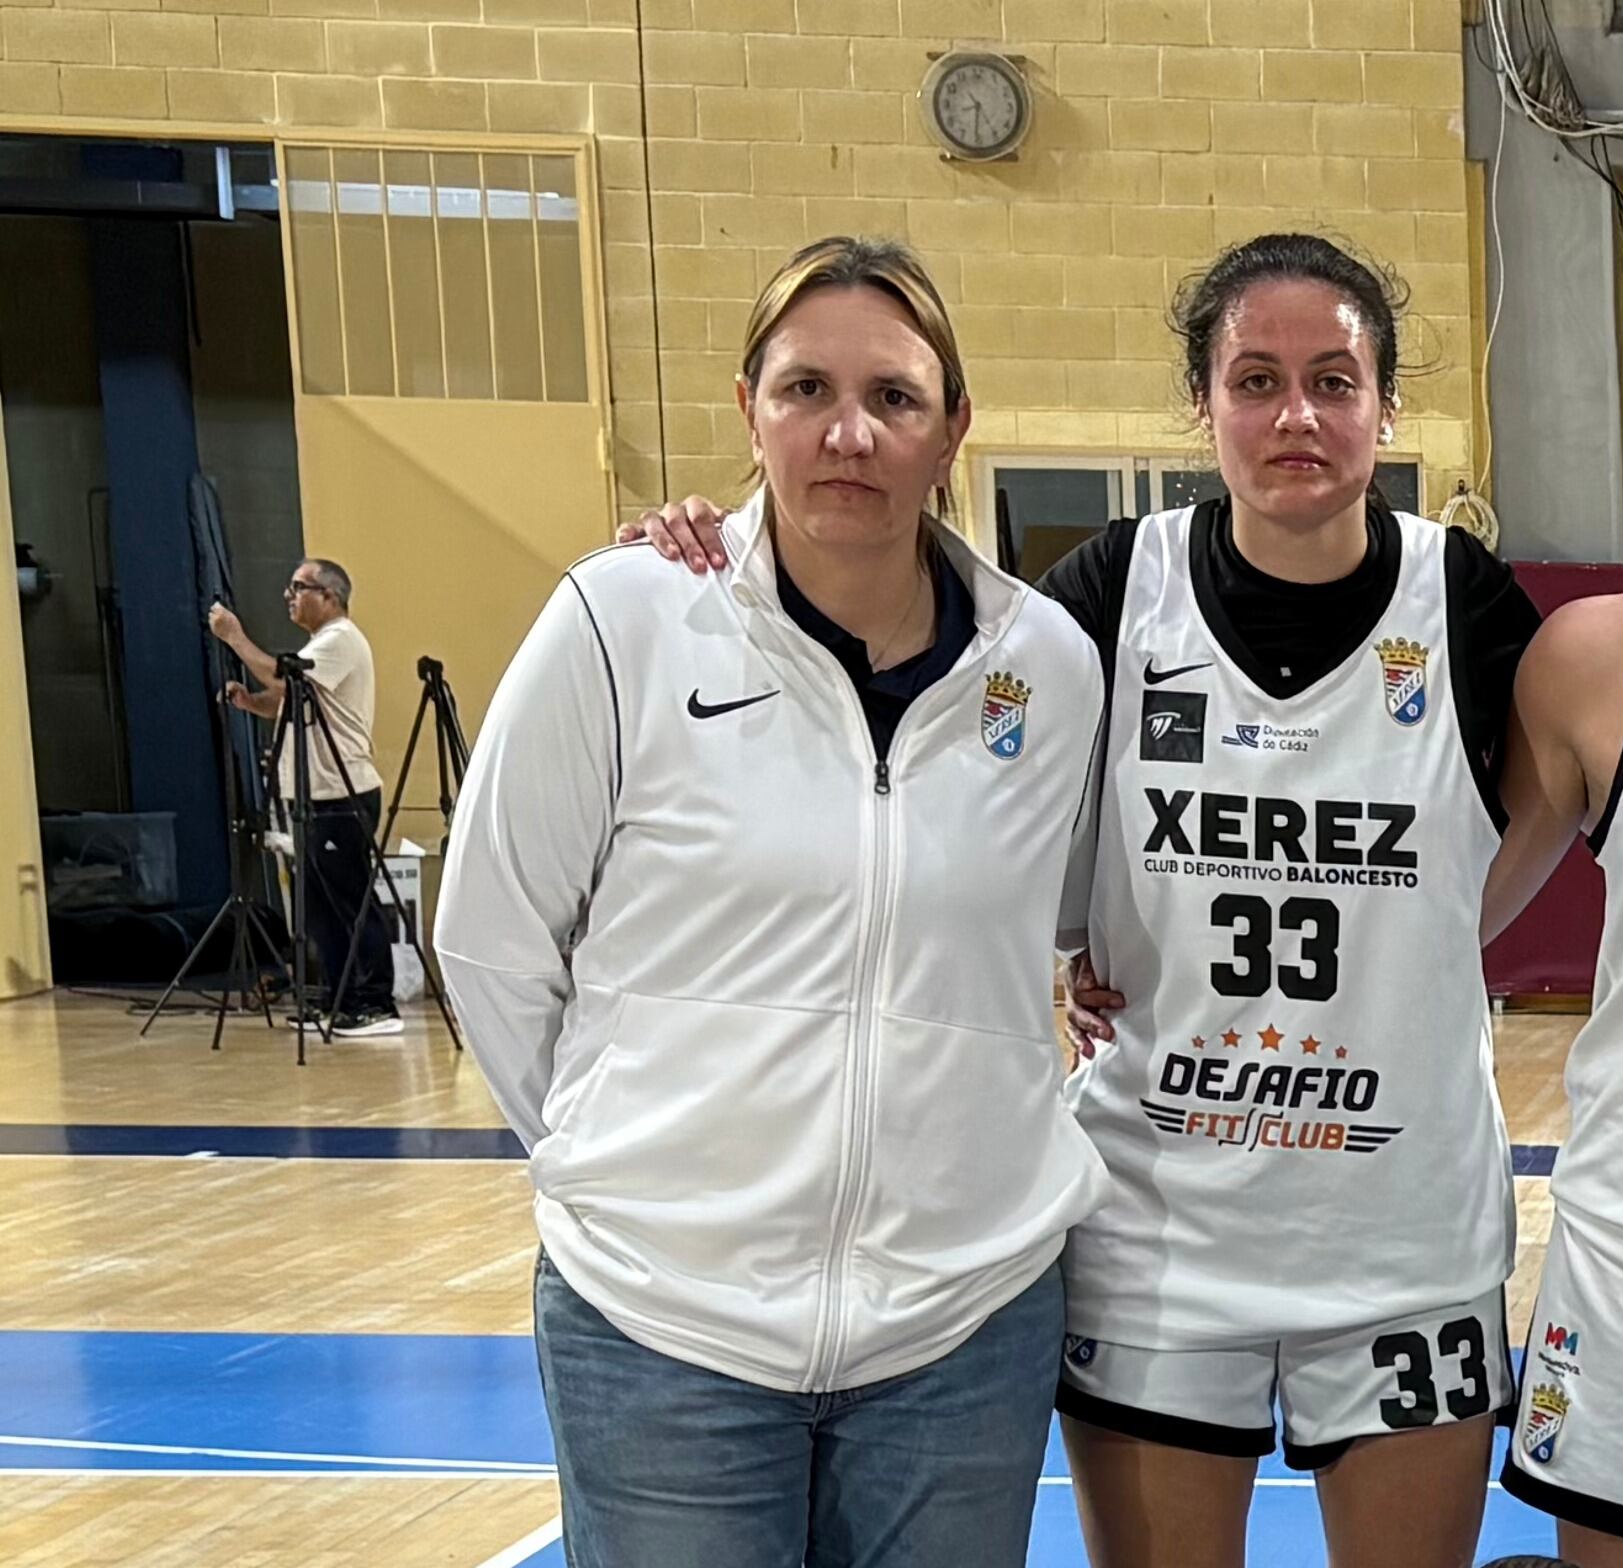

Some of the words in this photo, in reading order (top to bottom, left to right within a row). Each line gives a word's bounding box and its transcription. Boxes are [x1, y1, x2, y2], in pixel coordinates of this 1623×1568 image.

[1143, 786, 1419, 870] XEREZ
[1144, 859, 1179, 874] CLUB
[1183, 861, 1283, 882] DEPORTIVO
[1286, 867, 1420, 889] BALONCESTO
[1210, 894, 1341, 1002] 33
[1158, 1052, 1380, 1112] DESAFIO
[1261, 1112, 1348, 1150] CLUB
[1372, 1315, 1491, 1430] 33
